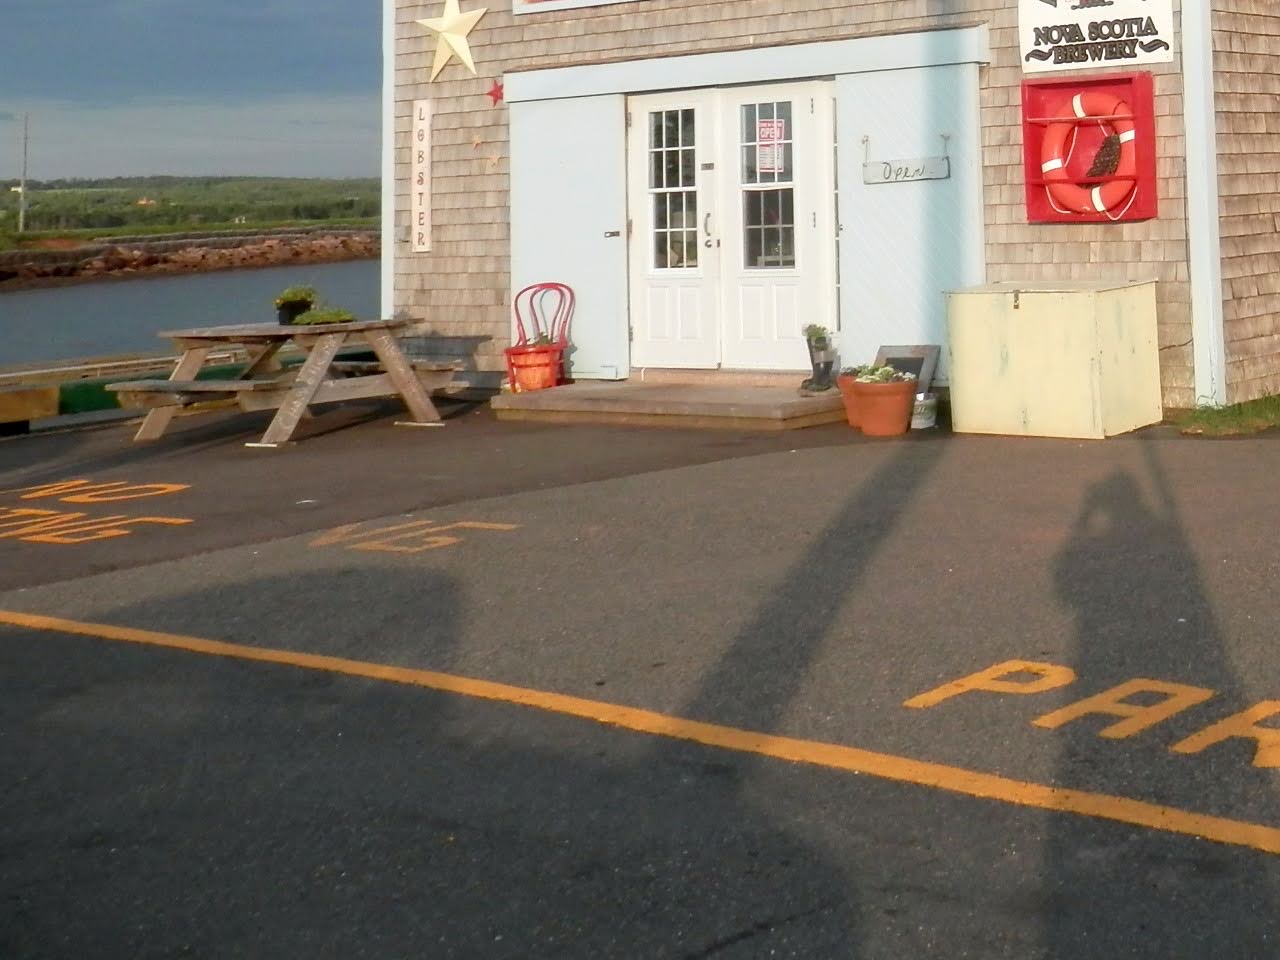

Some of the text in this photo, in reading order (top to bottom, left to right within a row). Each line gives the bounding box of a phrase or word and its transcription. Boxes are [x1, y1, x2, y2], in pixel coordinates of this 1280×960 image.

[1033, 16, 1158, 46] NOVA SCOTIA
[1052, 39, 1139, 65] BREWERY
[416, 107, 426, 246] LOBSTER
